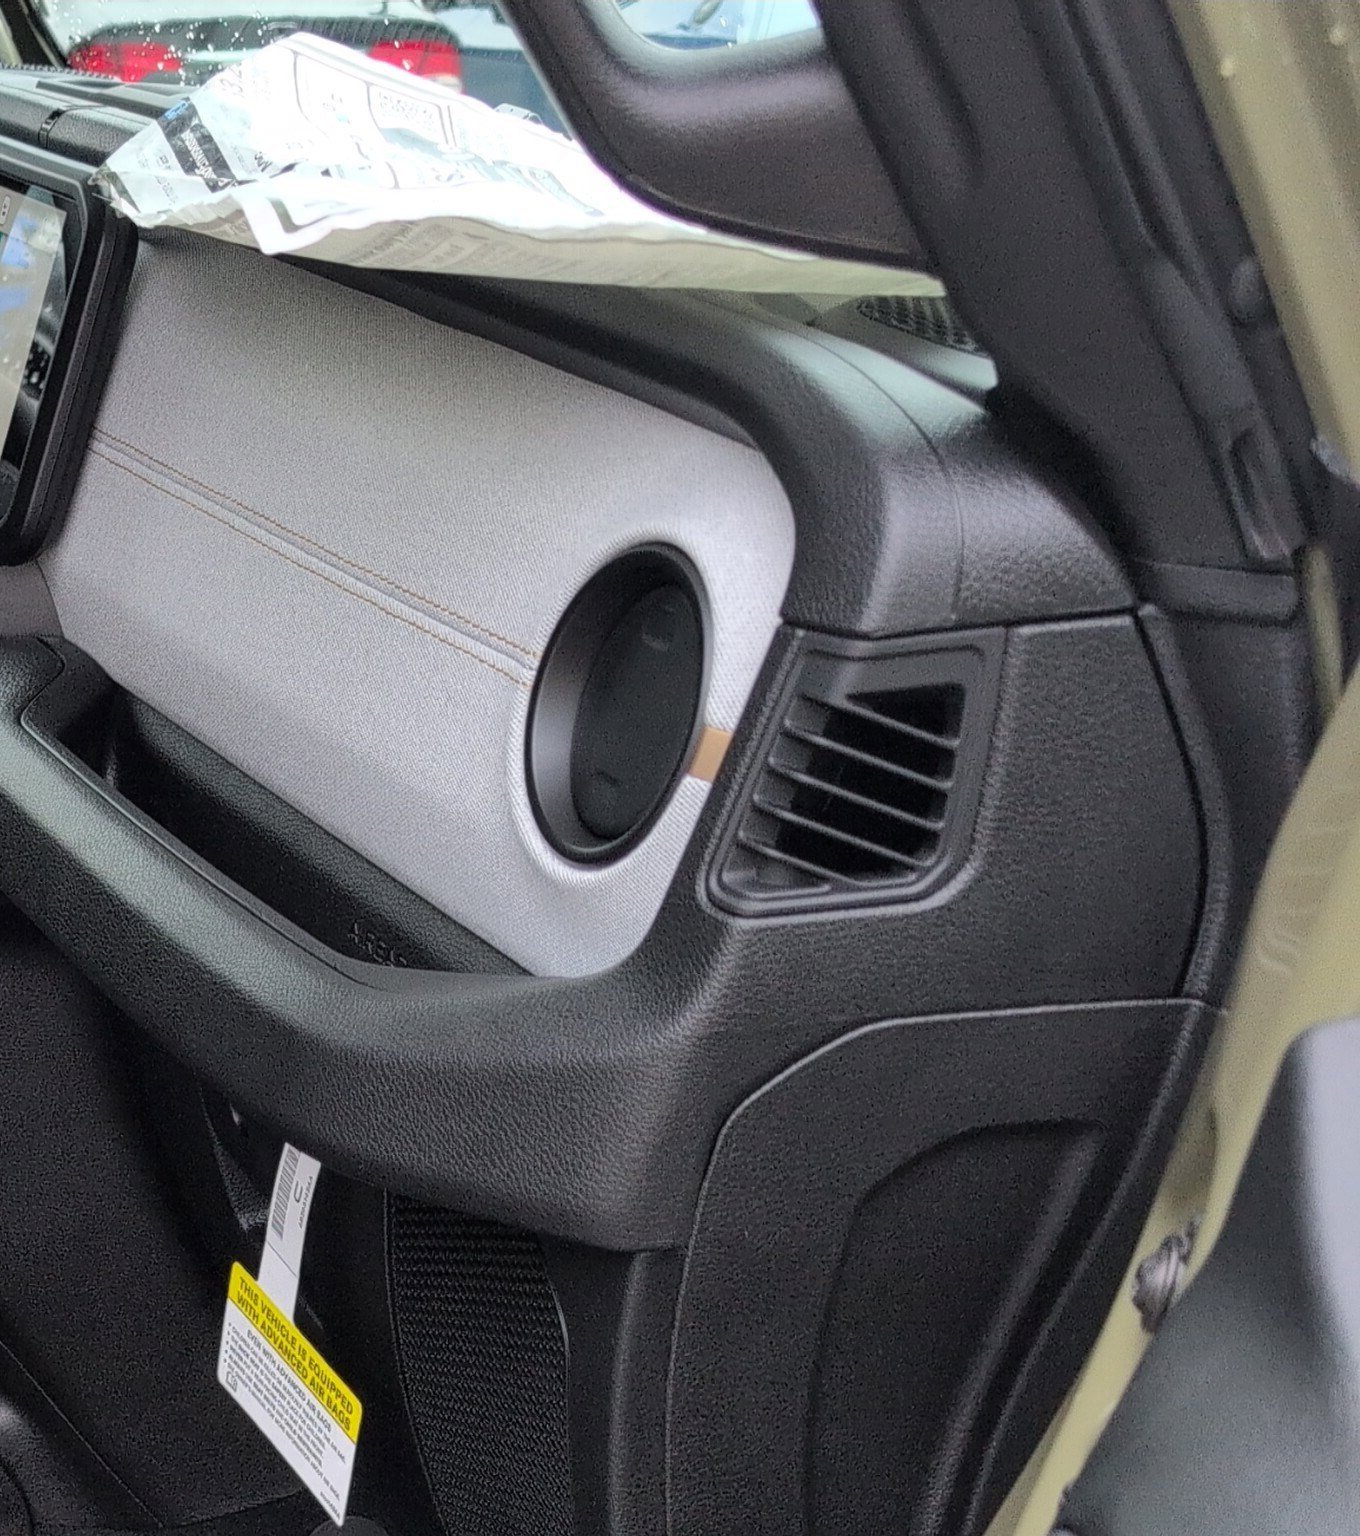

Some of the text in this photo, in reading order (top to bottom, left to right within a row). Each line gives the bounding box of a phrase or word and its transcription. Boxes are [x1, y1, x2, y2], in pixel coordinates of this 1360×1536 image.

[236, 1289, 351, 1432] WITH ADVANCED AIR BAGS
[238, 1275, 354, 1417] THIS VEHICLE IS EQUIPPED
